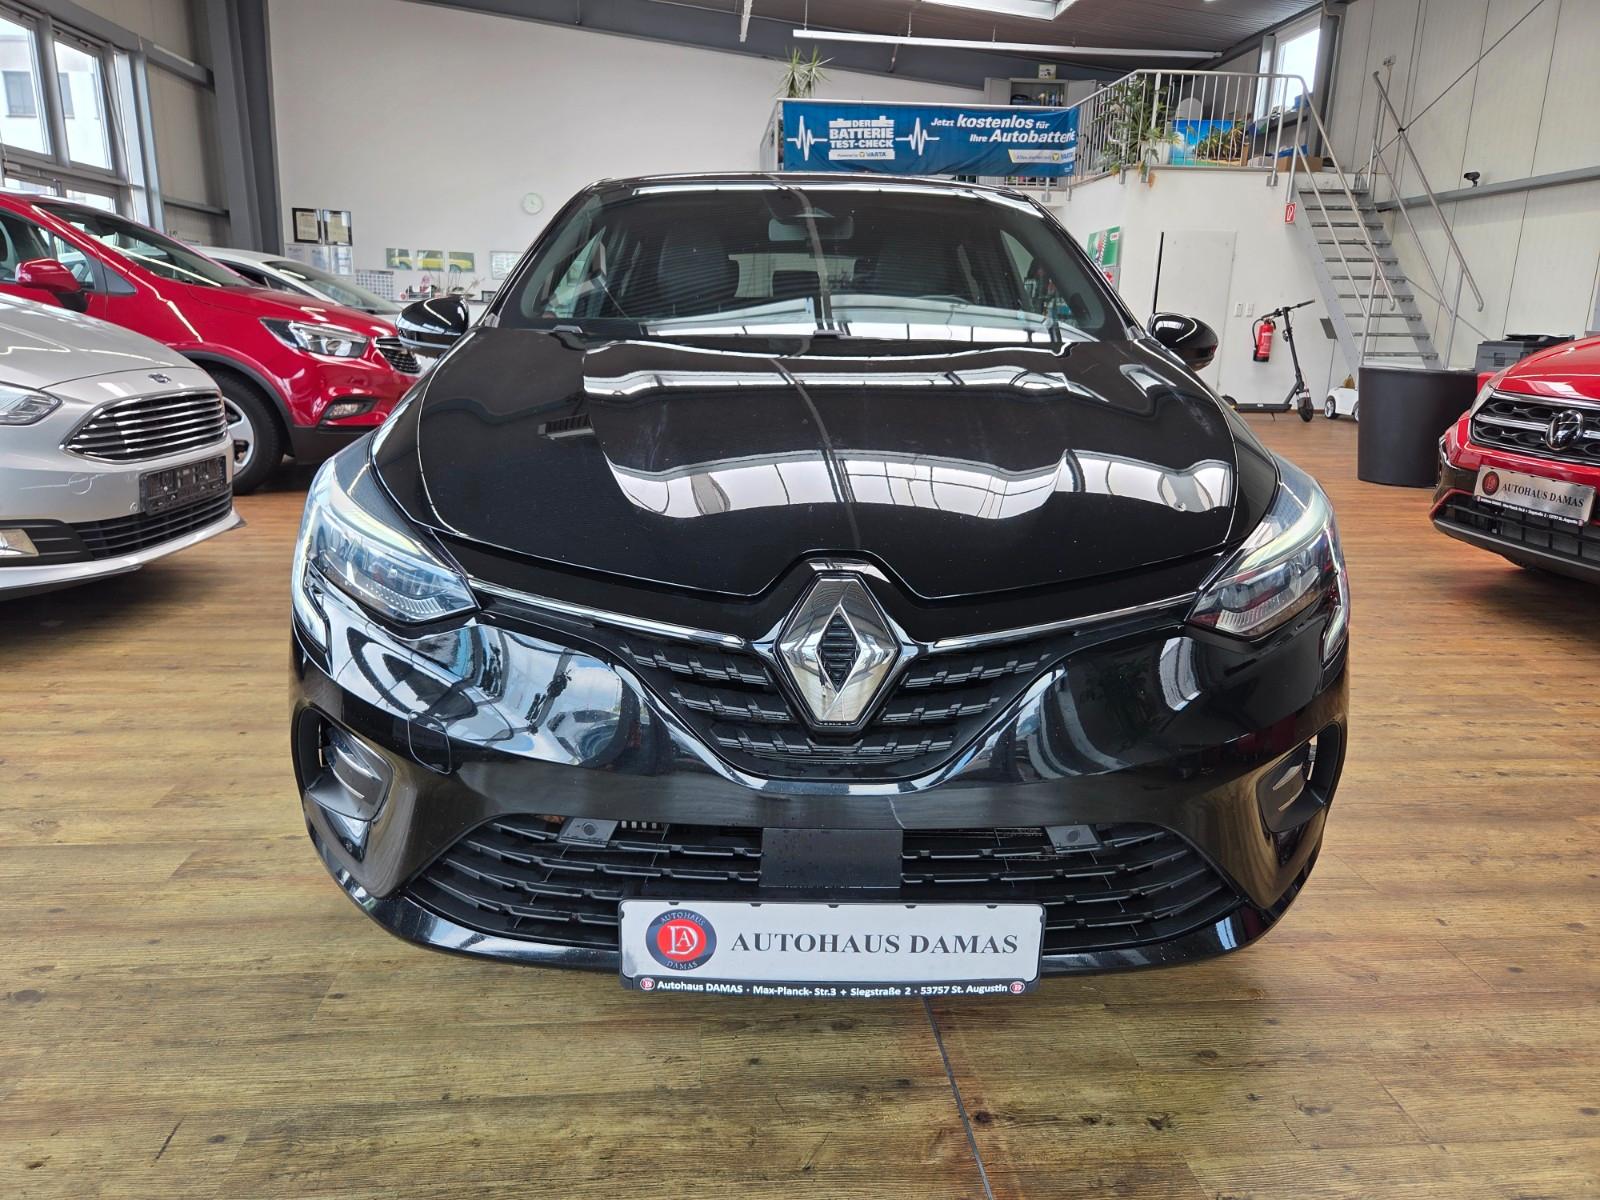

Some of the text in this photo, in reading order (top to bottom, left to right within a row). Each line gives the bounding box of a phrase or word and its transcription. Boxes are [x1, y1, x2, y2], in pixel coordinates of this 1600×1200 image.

[852, 119, 871, 128] DER
[931, 113, 1051, 129] Jetzt kostenlos für
[829, 128, 894, 140] BATTERIE
[969, 133, 988, 142] Ihre
[830, 139, 894, 149] TEST-CHECK
[1502, 483, 1585, 508] AUTOHAUS DAMAS
[659, 911, 707, 926] AUTOHAUS
[730, 932, 1019, 954] AUTOHAUS DAMAS
[666, 960, 699, 970] DAMAS
[657, 980, 704, 991] Autohaus
[706, 983, 744, 993] DAMAS
[850, 987, 901, 998] Siegstraße
[904, 987, 912, 996] 2
[920, 986, 950, 996] 53757
[951, 985, 964, 995] St.
[966, 984, 1008, 995] Augustin
